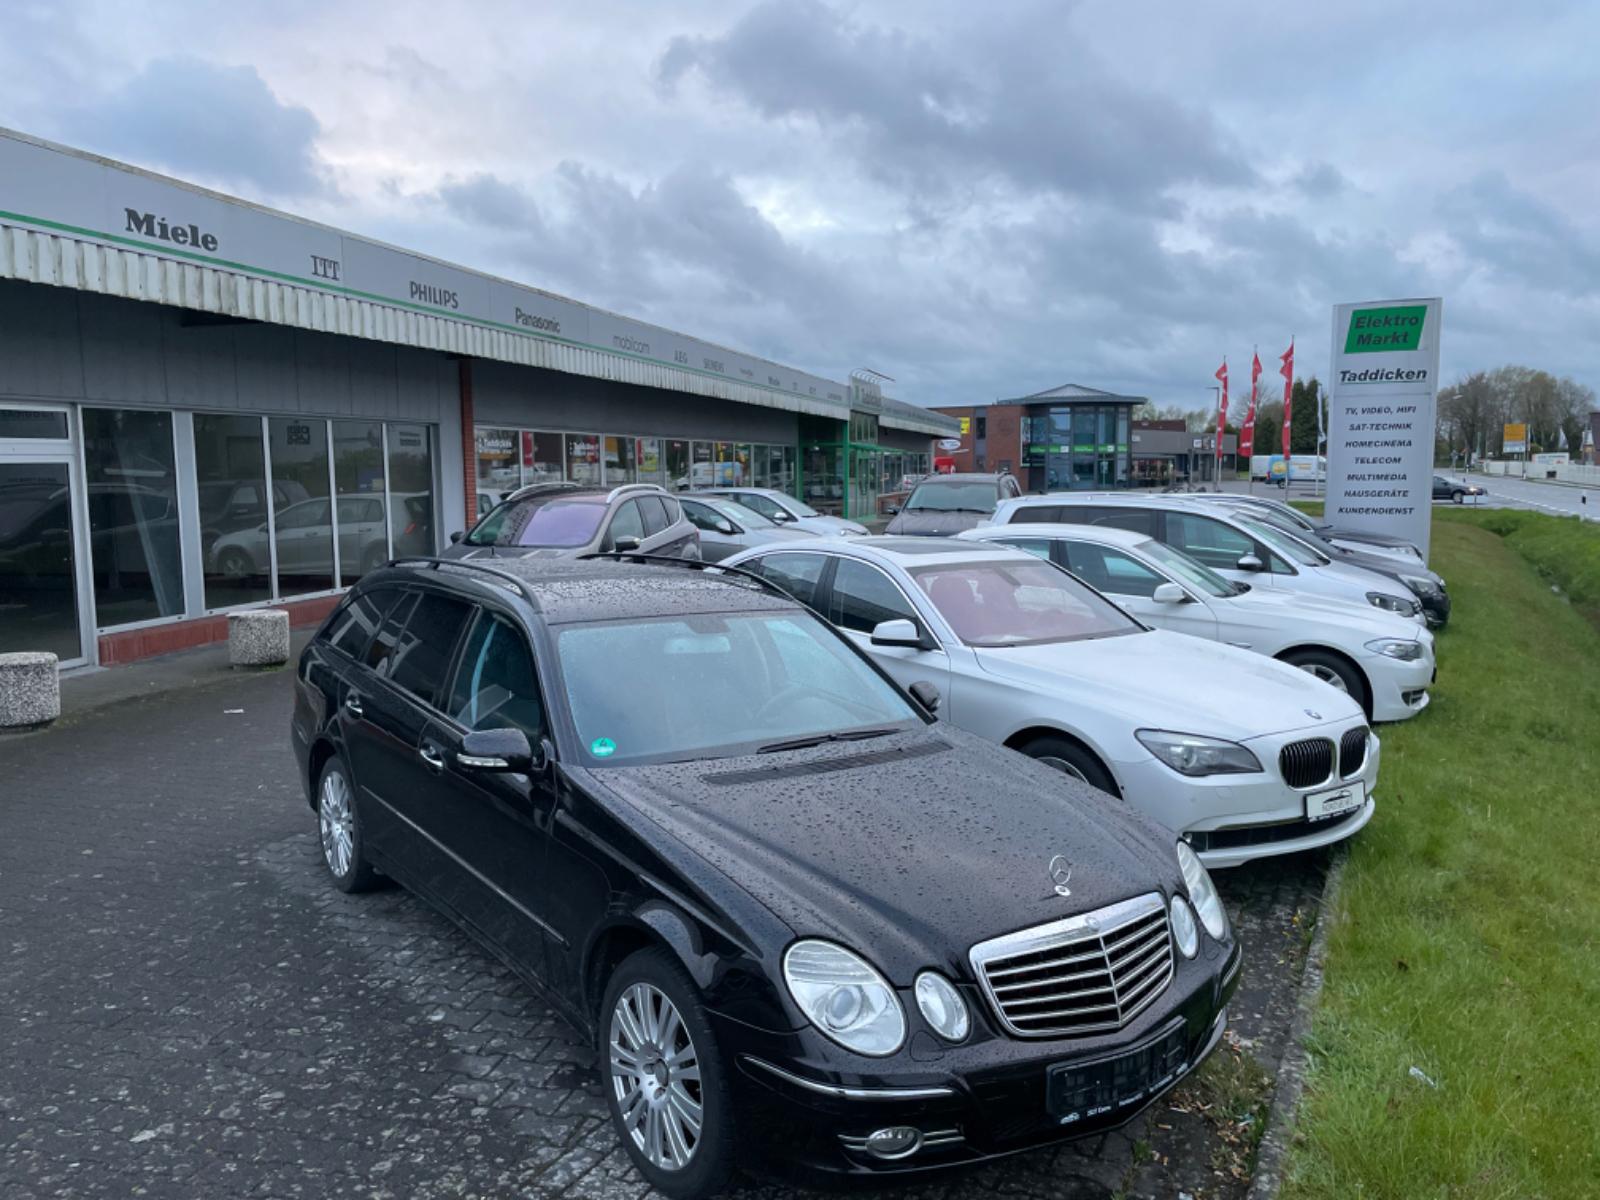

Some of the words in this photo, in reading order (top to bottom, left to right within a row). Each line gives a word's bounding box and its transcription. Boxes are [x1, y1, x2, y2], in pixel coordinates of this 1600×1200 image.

[125, 208, 218, 251] Miele
[310, 255, 340, 281] ITT
[409, 281, 459, 309] PHILIPS
[515, 307, 561, 333] Panasonic
[1354, 314, 1420, 329] Elektro
[1356, 331, 1409, 347] Markt
[1339, 368, 1427, 382] Taddicken
[1345, 407, 1358, 416] TV,
[1361, 406, 1393, 416] VIDEO,
[1396, 405, 1417, 414] HIFI
[1349, 423, 1413, 431] SAT-TECHNIK
[1345, 440, 1413, 448] HOMECINEMA
[1354, 456, 1402, 465] TELECOM
[1347, 473, 1408, 481] MULTIMEDIA
[1344, 488, 1409, 498] HAUSGERÄTE
[1338, 506, 1415, 515] KUNDENDIENST
